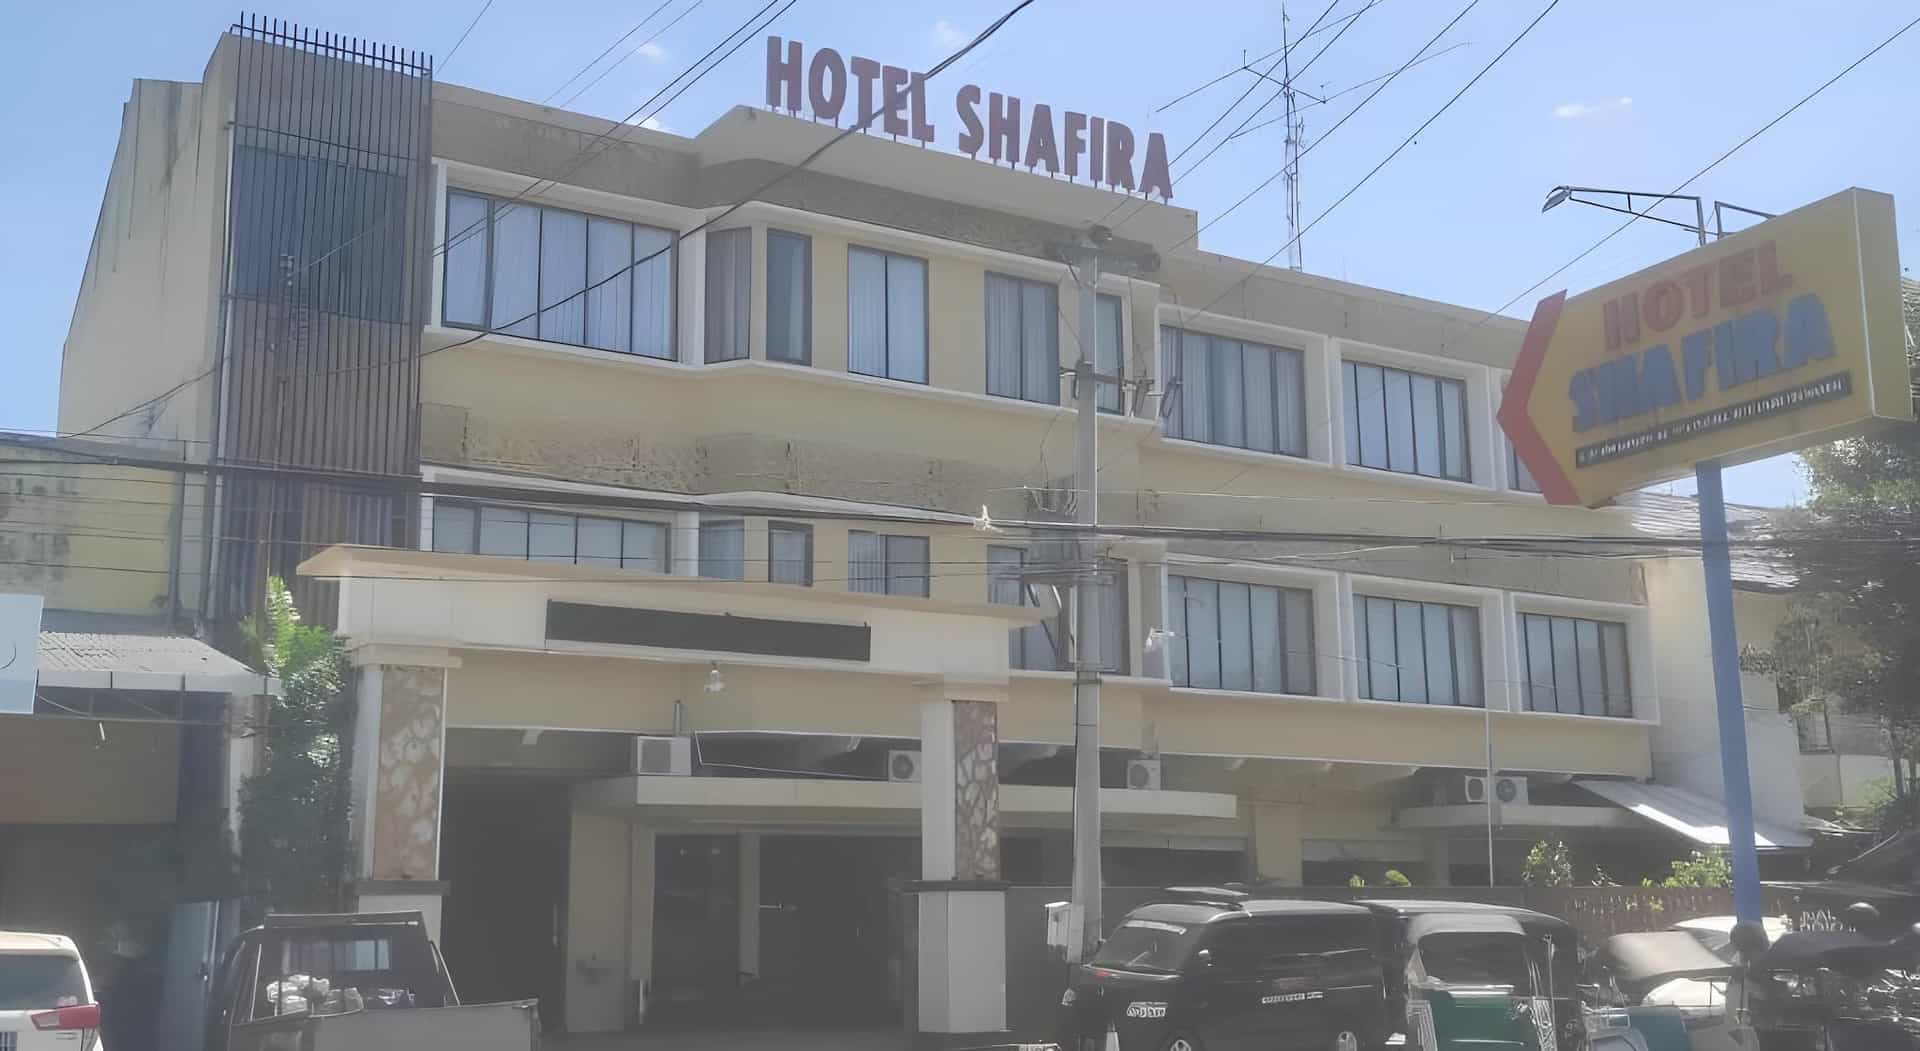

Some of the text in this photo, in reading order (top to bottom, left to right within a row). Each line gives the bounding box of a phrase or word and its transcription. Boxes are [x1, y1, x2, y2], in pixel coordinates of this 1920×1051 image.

[766, 36, 1173, 199] HOTEL SHAFIRA
[1568, 293, 1836, 433] SHAFIRA
[1603, 240, 1796, 352] HOTEL
